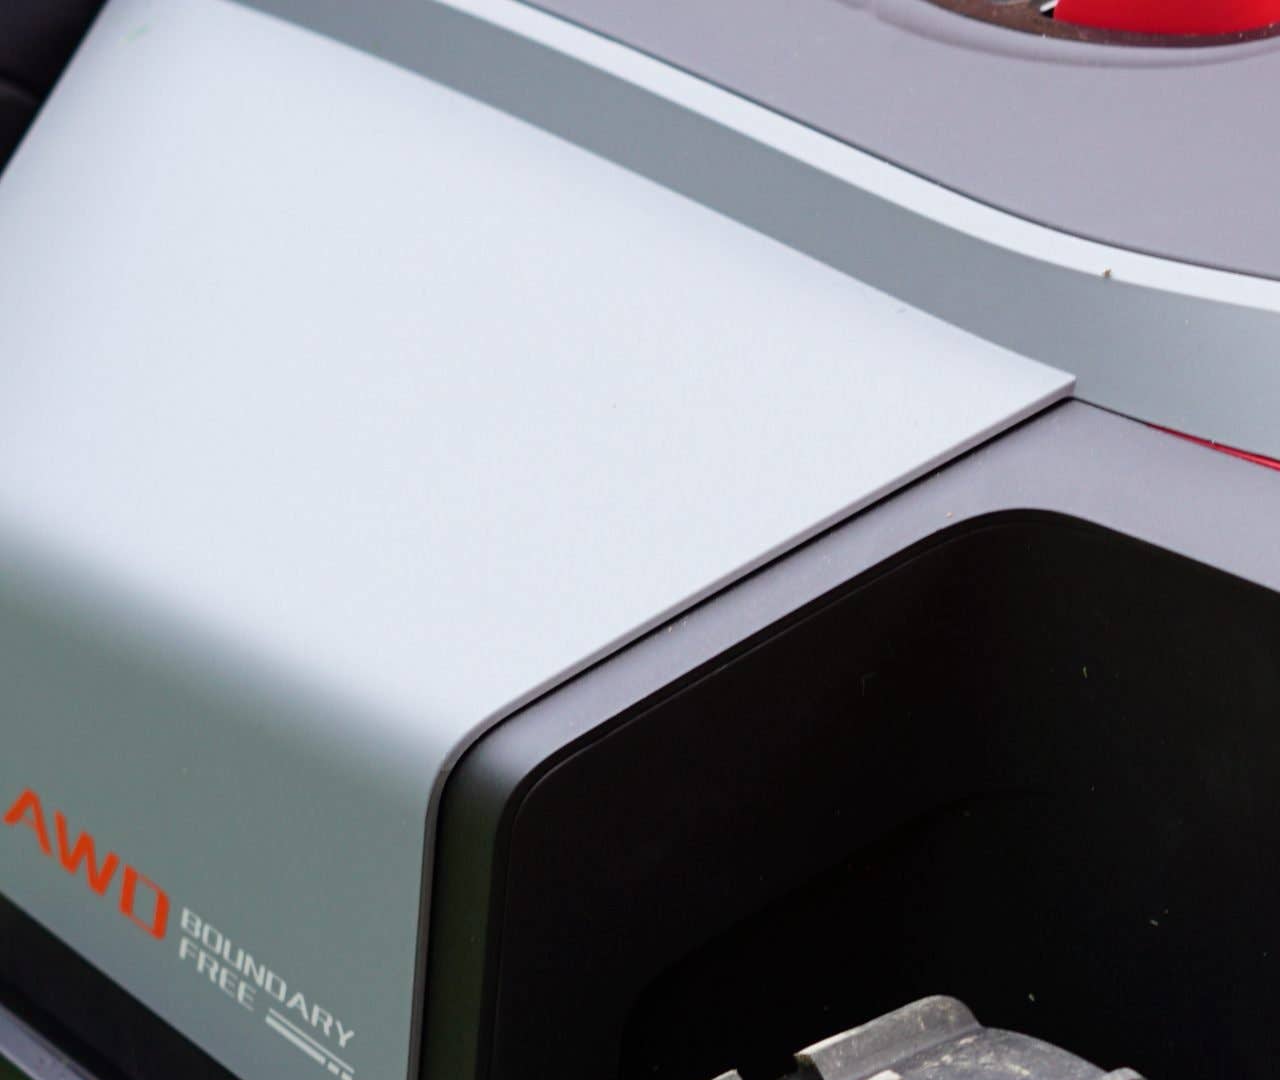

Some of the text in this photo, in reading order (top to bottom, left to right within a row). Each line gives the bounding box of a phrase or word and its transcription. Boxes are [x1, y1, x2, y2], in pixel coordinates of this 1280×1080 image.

[4, 787, 170, 940] AWD
[178, 937, 256, 1011] FREE
[180, 906, 355, 1048] BOUNDARY
